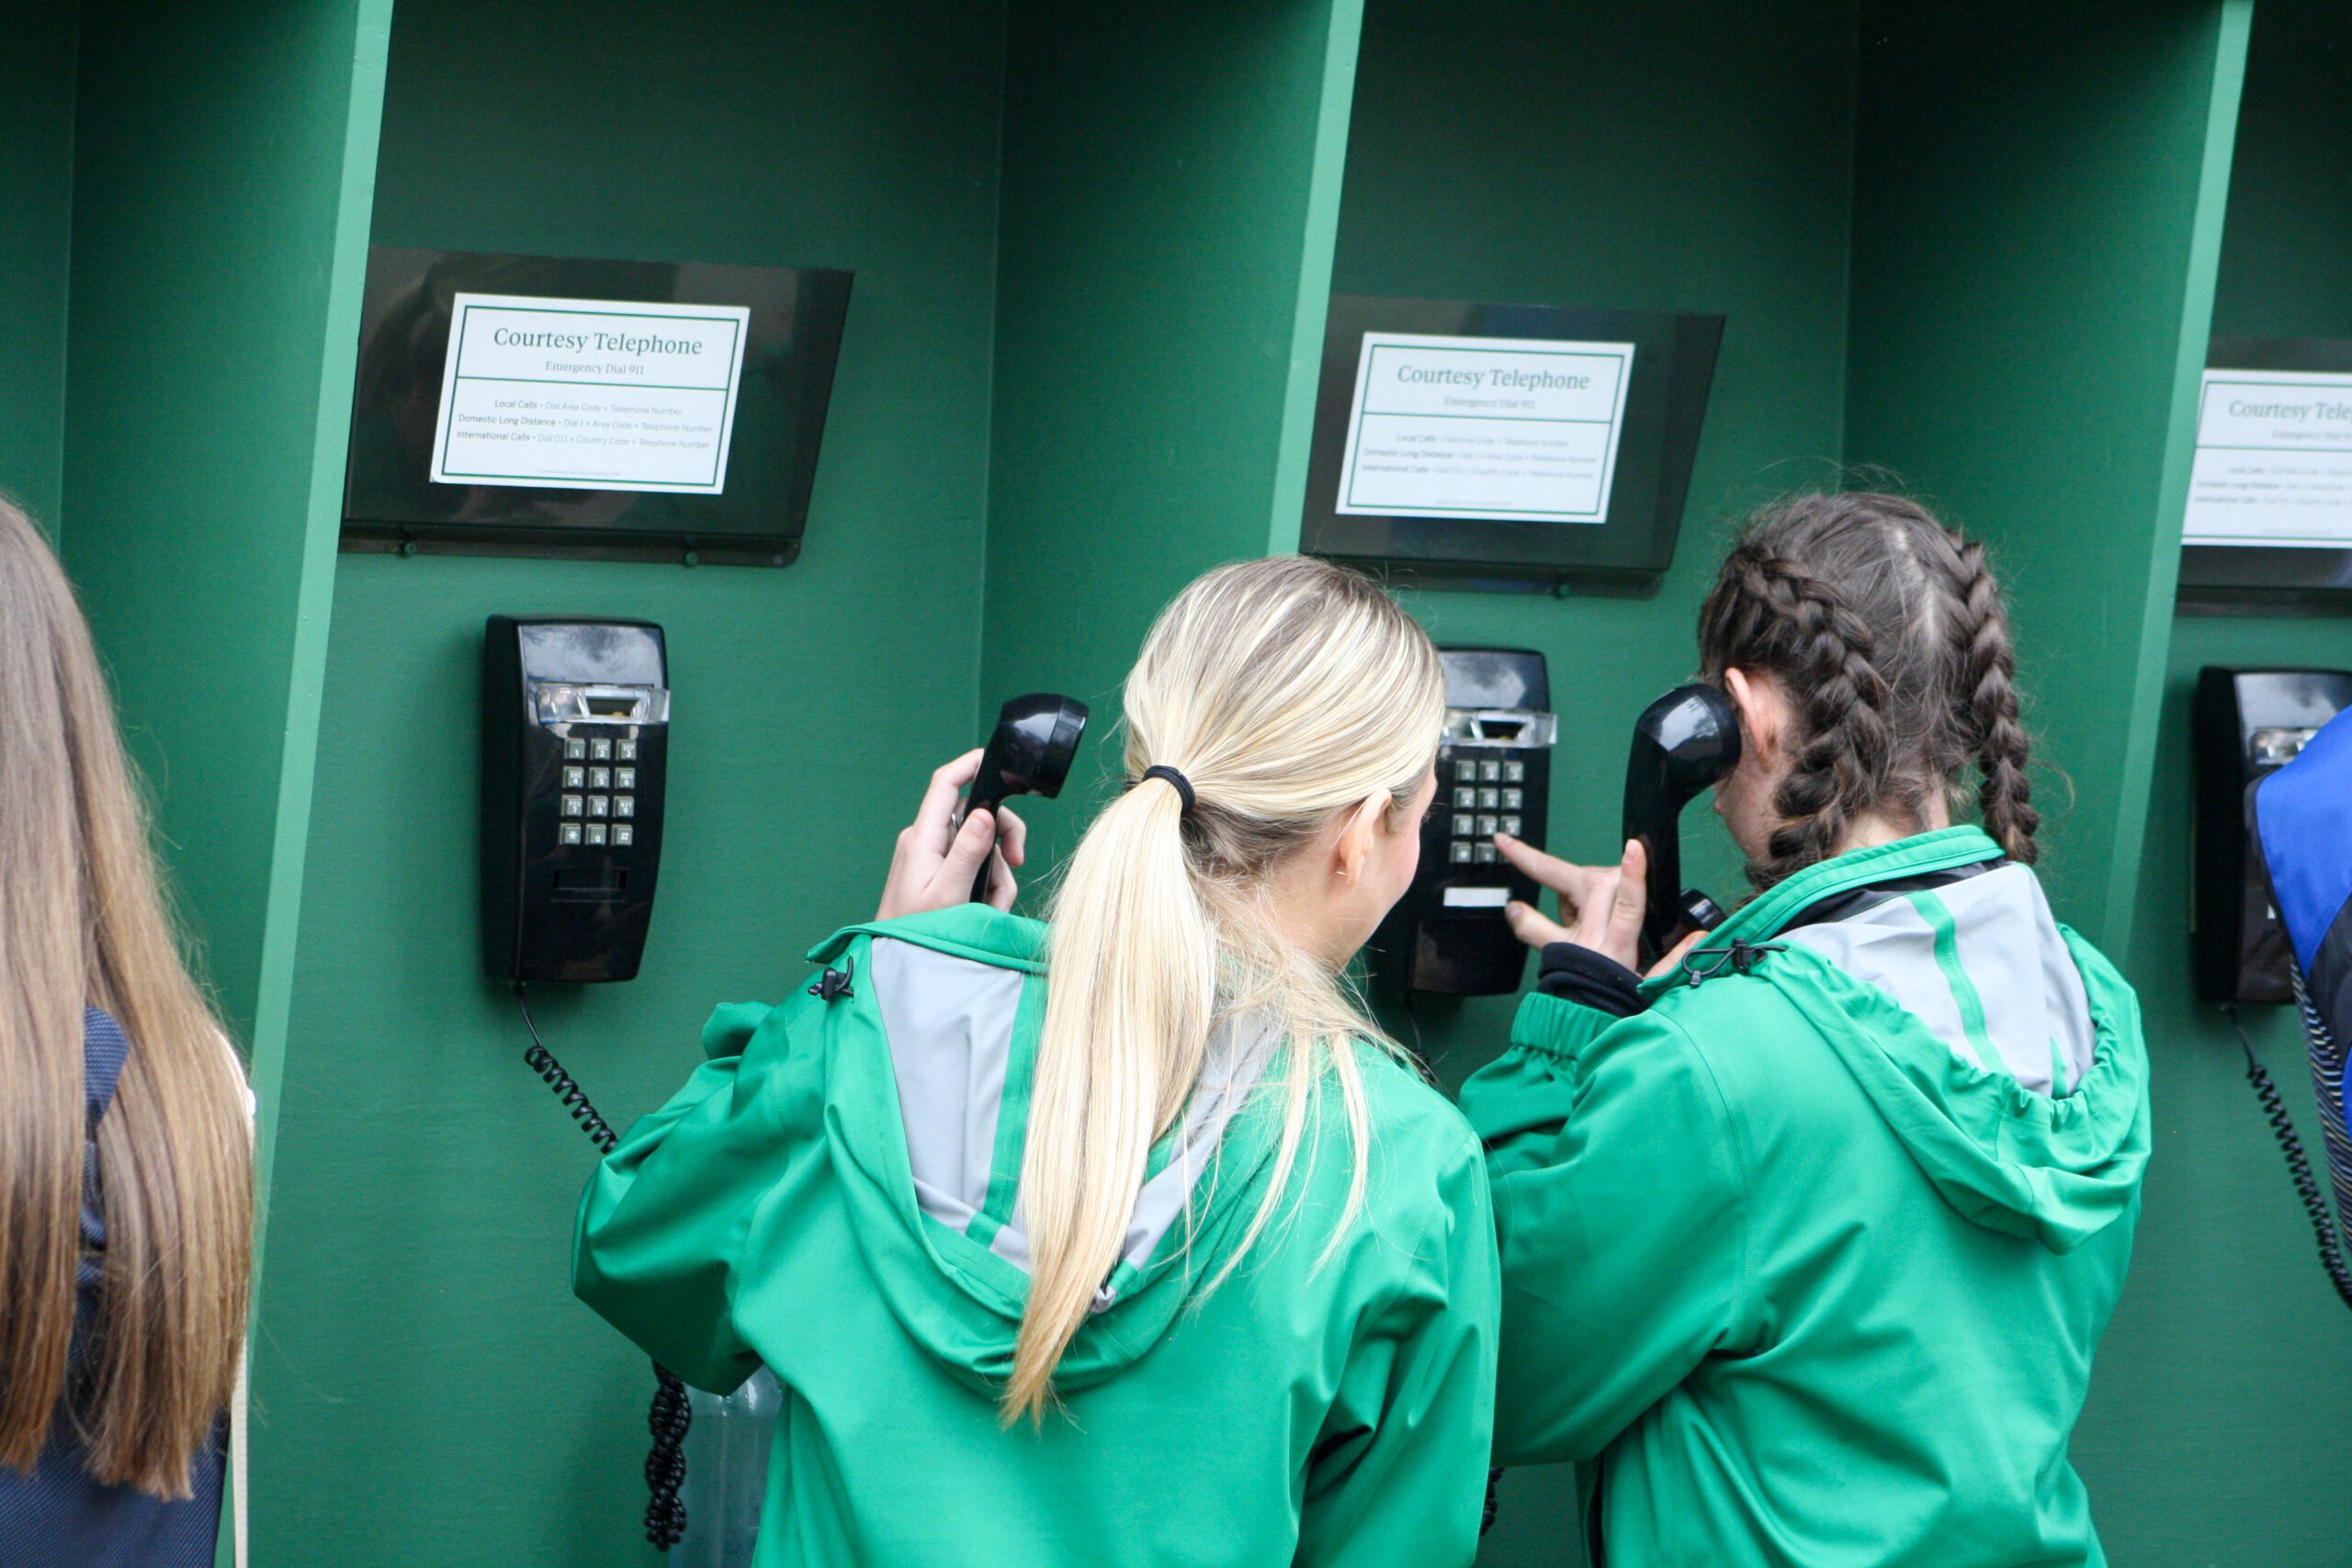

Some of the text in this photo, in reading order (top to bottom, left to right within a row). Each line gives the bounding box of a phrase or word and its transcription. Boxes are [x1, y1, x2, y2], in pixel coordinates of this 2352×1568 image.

[493, 327, 703, 357] Courtesy Telephone
[545, 361, 644, 376] Emergency Dial 911
[1397, 366, 1590, 391] Courtesy Telephone
[494, 399, 516, 409] Local
[517, 400, 537, 410] Calls
[545, 401, 560, 411] Dial
[561, 402, 580, 412] Area
[581, 403, 602, 412] Code
[610, 404, 650, 414] Telephone
[650, 406, 683, 415] Number
[1443, 396, 1498, 409] Emergency
[2229, 400, 2311, 423] Courtesy
[458, 413, 498, 424] Domestic
[499, 416, 519, 426] Long
[521, 417, 556, 427] Distance
[563, 419, 579, 427] Dial
[592, 420, 611, 429] Area
[611, 421, 632, 430] Code
[641, 422, 680, 433] Telephone
[681, 423, 713, 434] Number
[457, 430, 509, 441] International
[511, 433, 531, 442] Calls
[537, 434, 553, 442] Dial
[575, 434, 607, 446] Country
[609, 436, 629, 446] Code
[639, 438, 677, 448] Telephone
[678, 440, 710, 449] Number
